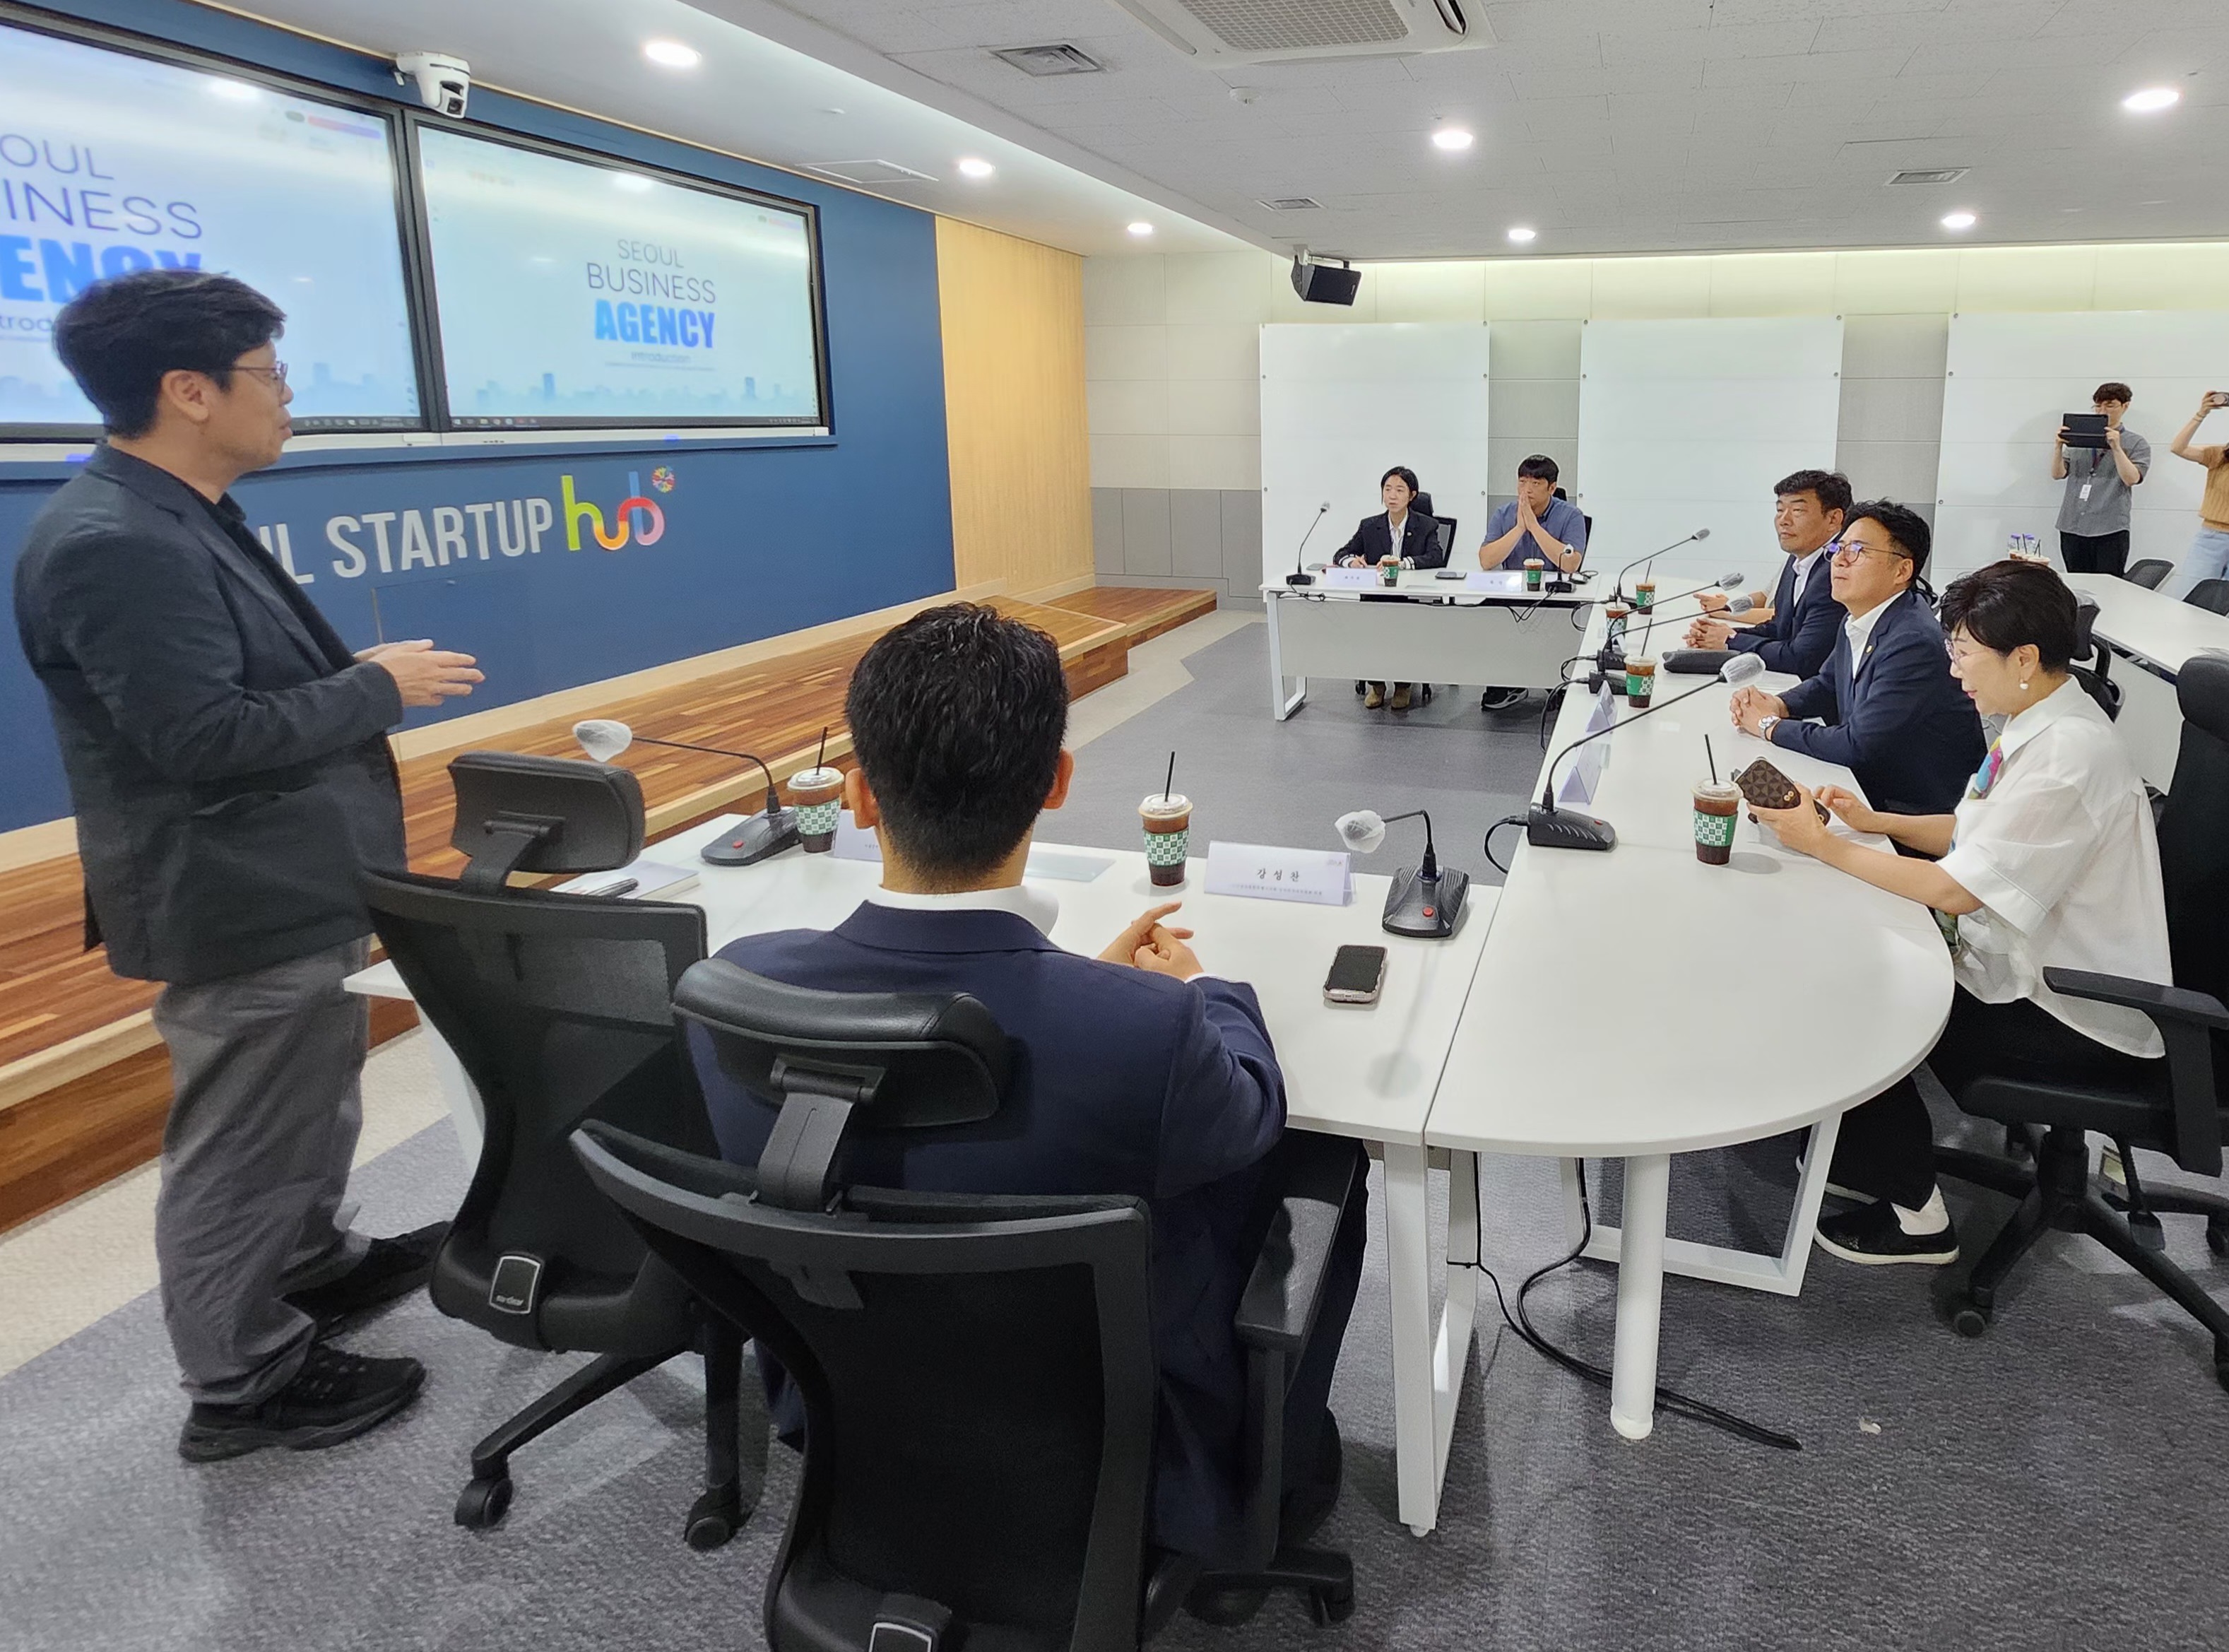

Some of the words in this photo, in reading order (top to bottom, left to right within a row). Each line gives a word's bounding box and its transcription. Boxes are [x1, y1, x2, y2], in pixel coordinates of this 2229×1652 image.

[617, 239, 685, 269] SEOUL
[587, 262, 716, 304] BUSINESS
[595, 298, 715, 348] AGENCY
[326, 497, 553, 579] STARTUP
[562, 471, 666, 551] hub
